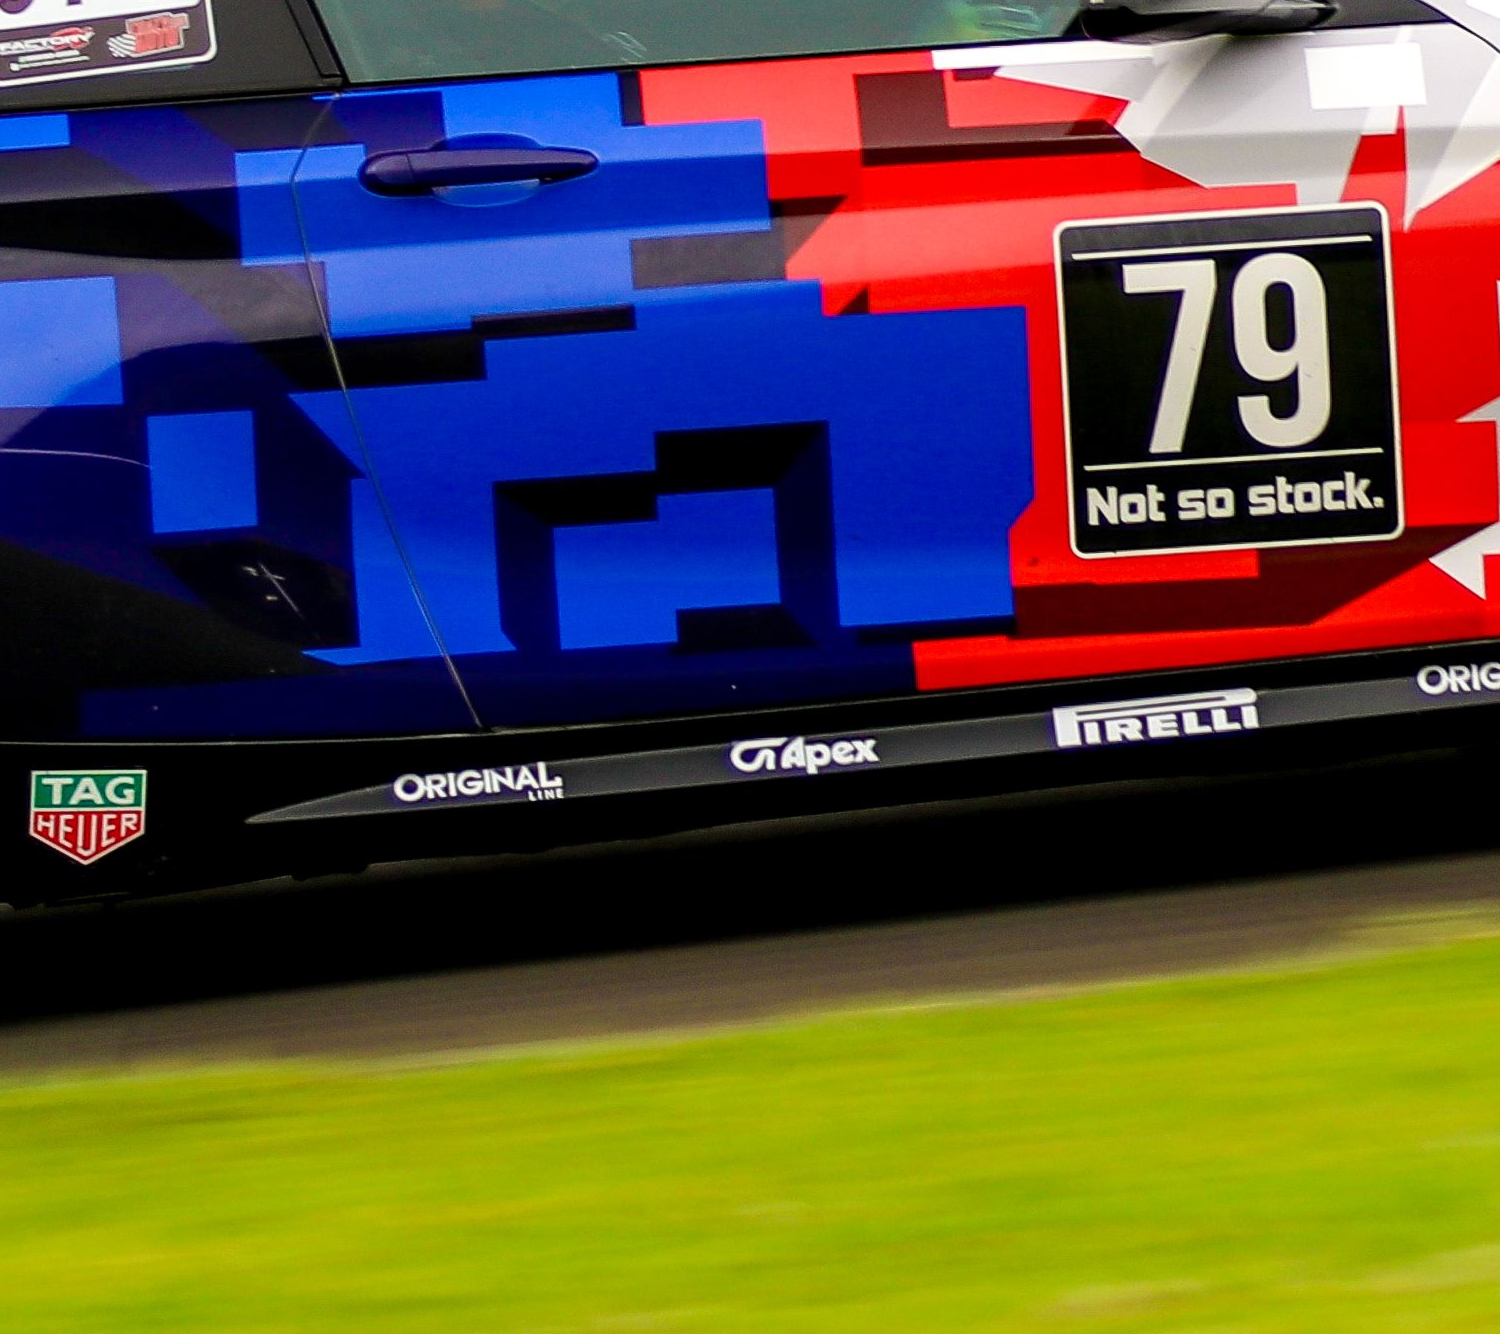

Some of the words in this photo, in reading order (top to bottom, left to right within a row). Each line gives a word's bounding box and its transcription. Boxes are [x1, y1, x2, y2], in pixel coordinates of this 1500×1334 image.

[1123, 252, 1332, 454] 79
[1086, 485, 1166, 527] Not
[1177, 487, 1235, 521] so
[1248, 470, 1385, 517] stock.
[1052, 687, 1259, 748] PIRELLI
[41, 776, 135, 805] TAG
[393, 761, 563, 802] ORIGINAL
[528, 788, 565, 802] LINE
[37, 812, 138, 857] HEUER
